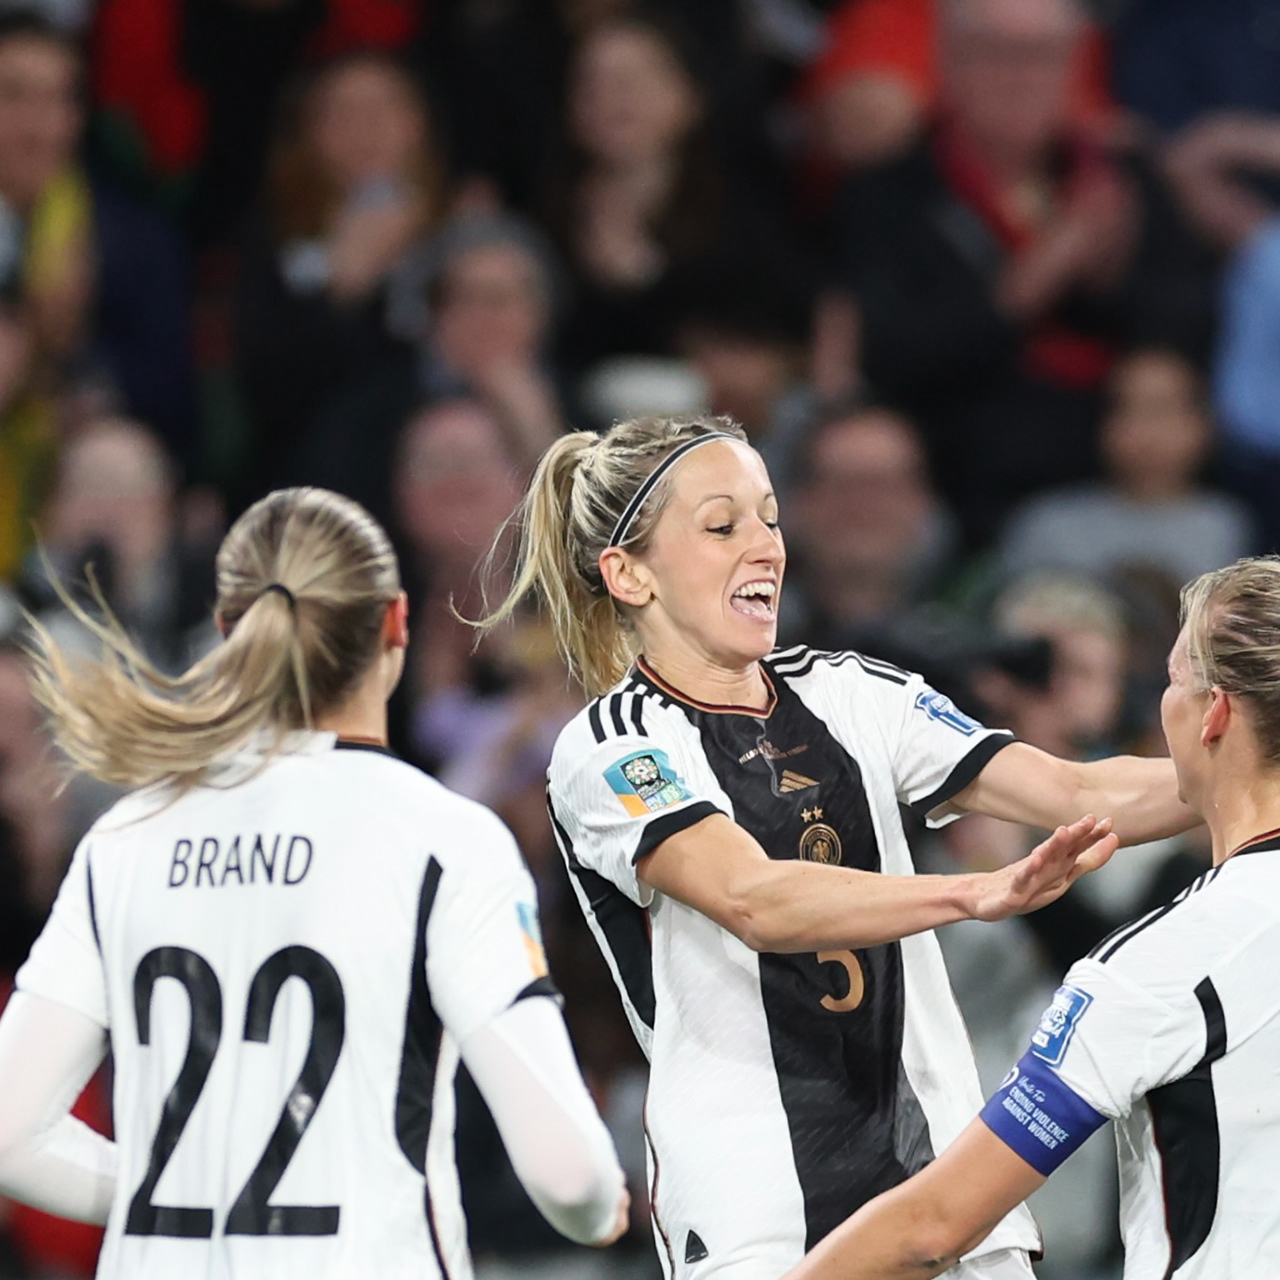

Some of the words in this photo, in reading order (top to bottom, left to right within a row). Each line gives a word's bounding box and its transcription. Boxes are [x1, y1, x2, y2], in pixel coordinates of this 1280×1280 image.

[167, 834, 314, 888] BRAND
[124, 944, 346, 1239] 22
[1009, 1086, 1036, 1113] ENDING
[1032, 1107, 1070, 1143] VIOLENCE
[1002, 1096, 1031, 1126] AGAINST
[1027, 1121, 1059, 1150] WOMEN
